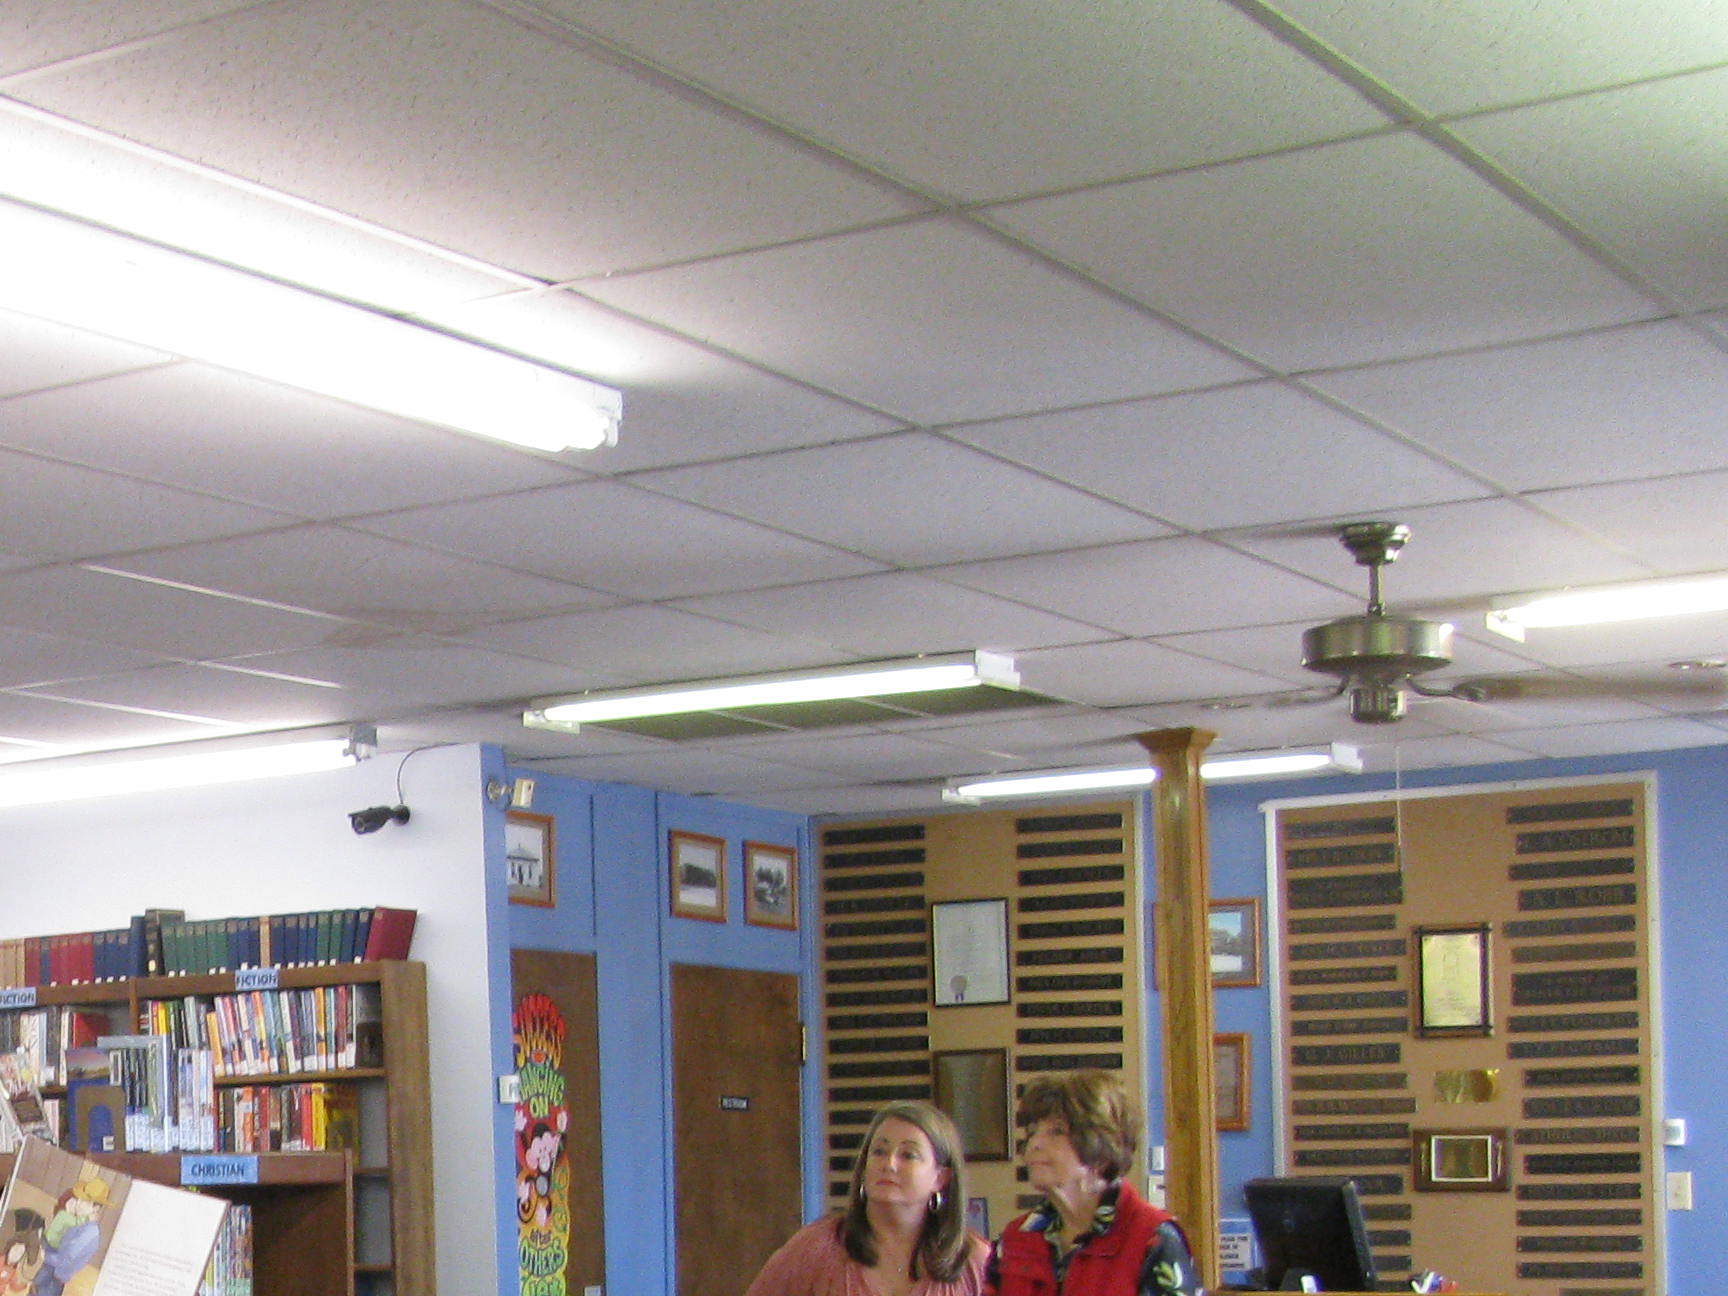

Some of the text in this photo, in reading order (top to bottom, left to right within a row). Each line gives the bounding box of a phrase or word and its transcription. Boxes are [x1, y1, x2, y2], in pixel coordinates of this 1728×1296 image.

[236, 973, 277, 987] FICTION
[529, 1096, 549, 1118] ON
[191, 1163, 244, 1177] CHRISTIAN
[520, 1238, 564, 1276] OTHERS
